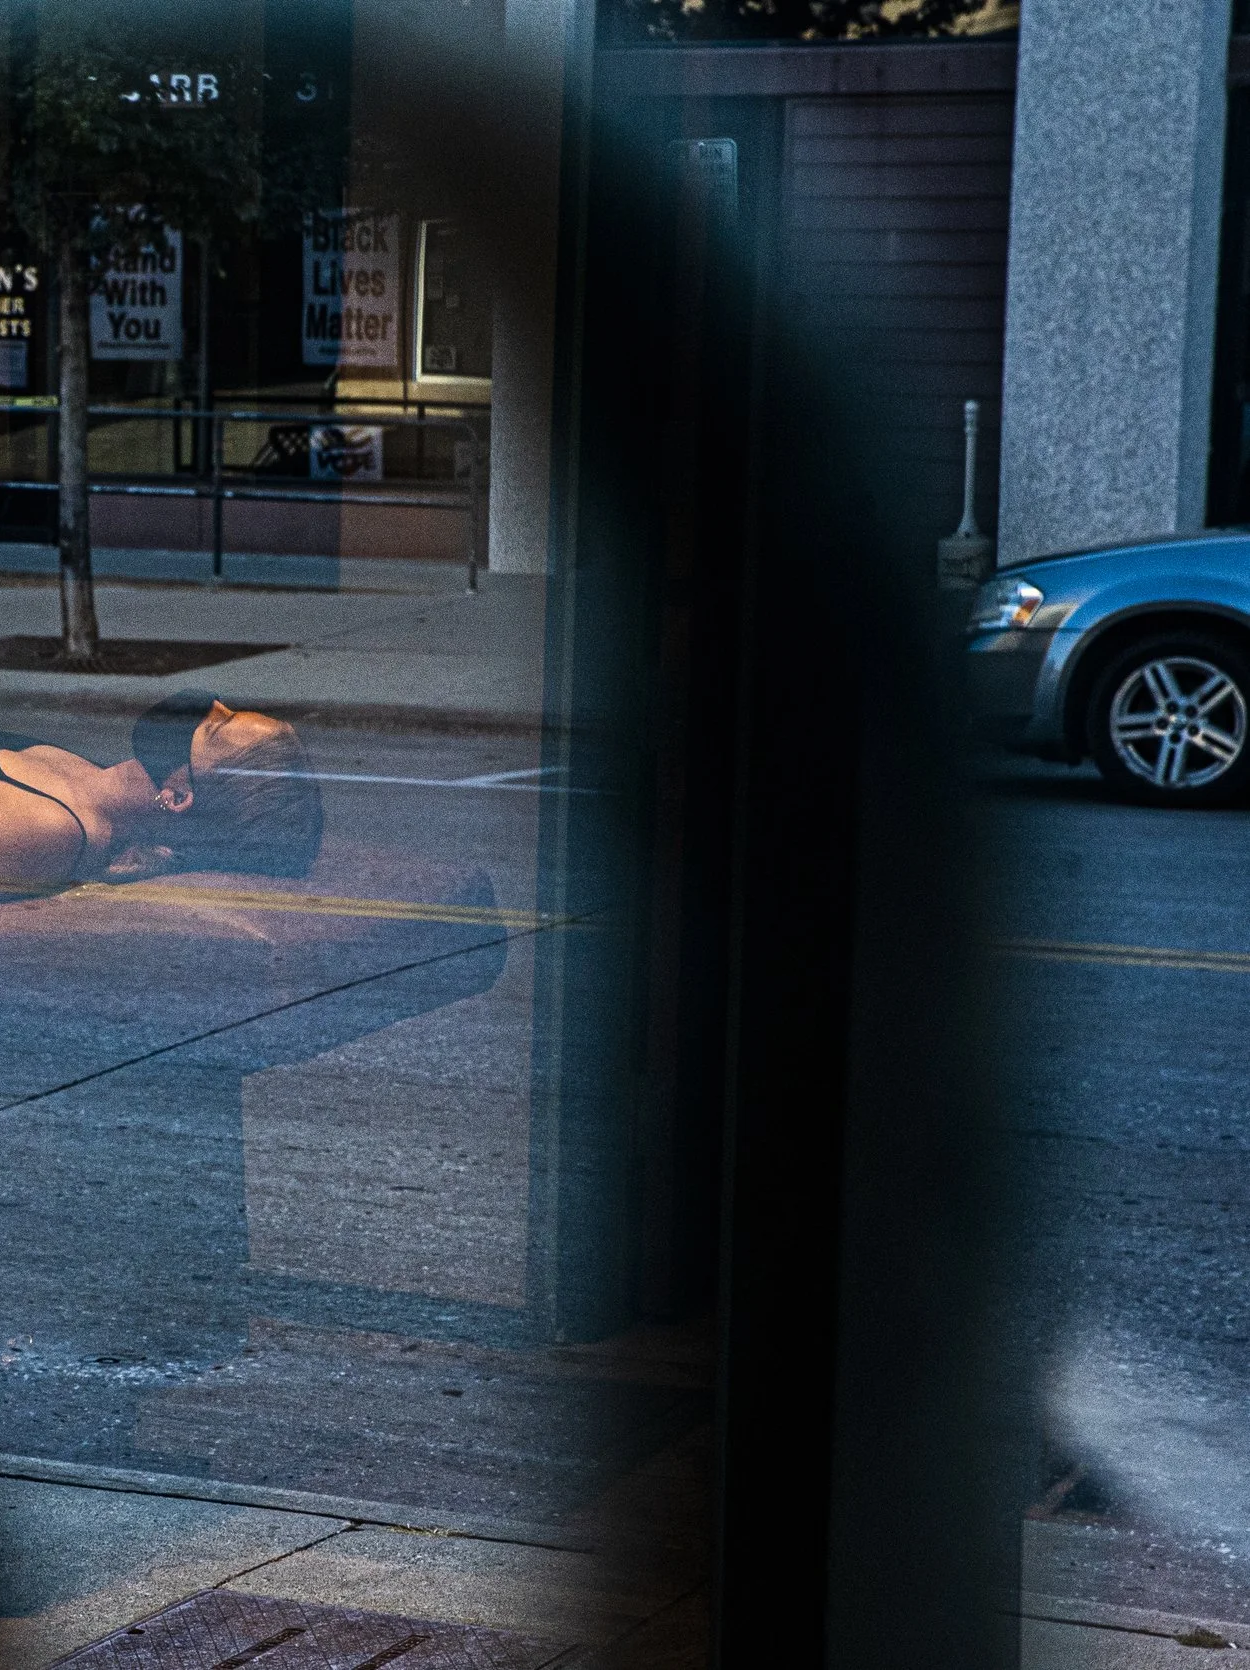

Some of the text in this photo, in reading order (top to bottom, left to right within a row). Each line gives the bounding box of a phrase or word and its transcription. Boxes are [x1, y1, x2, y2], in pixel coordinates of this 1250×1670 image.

[312, 214, 390, 252] Black
[106, 279, 168, 306] With
[313, 260, 386, 297] Lives
[108, 312, 161, 340] You
[305, 303, 393, 341] Matter
